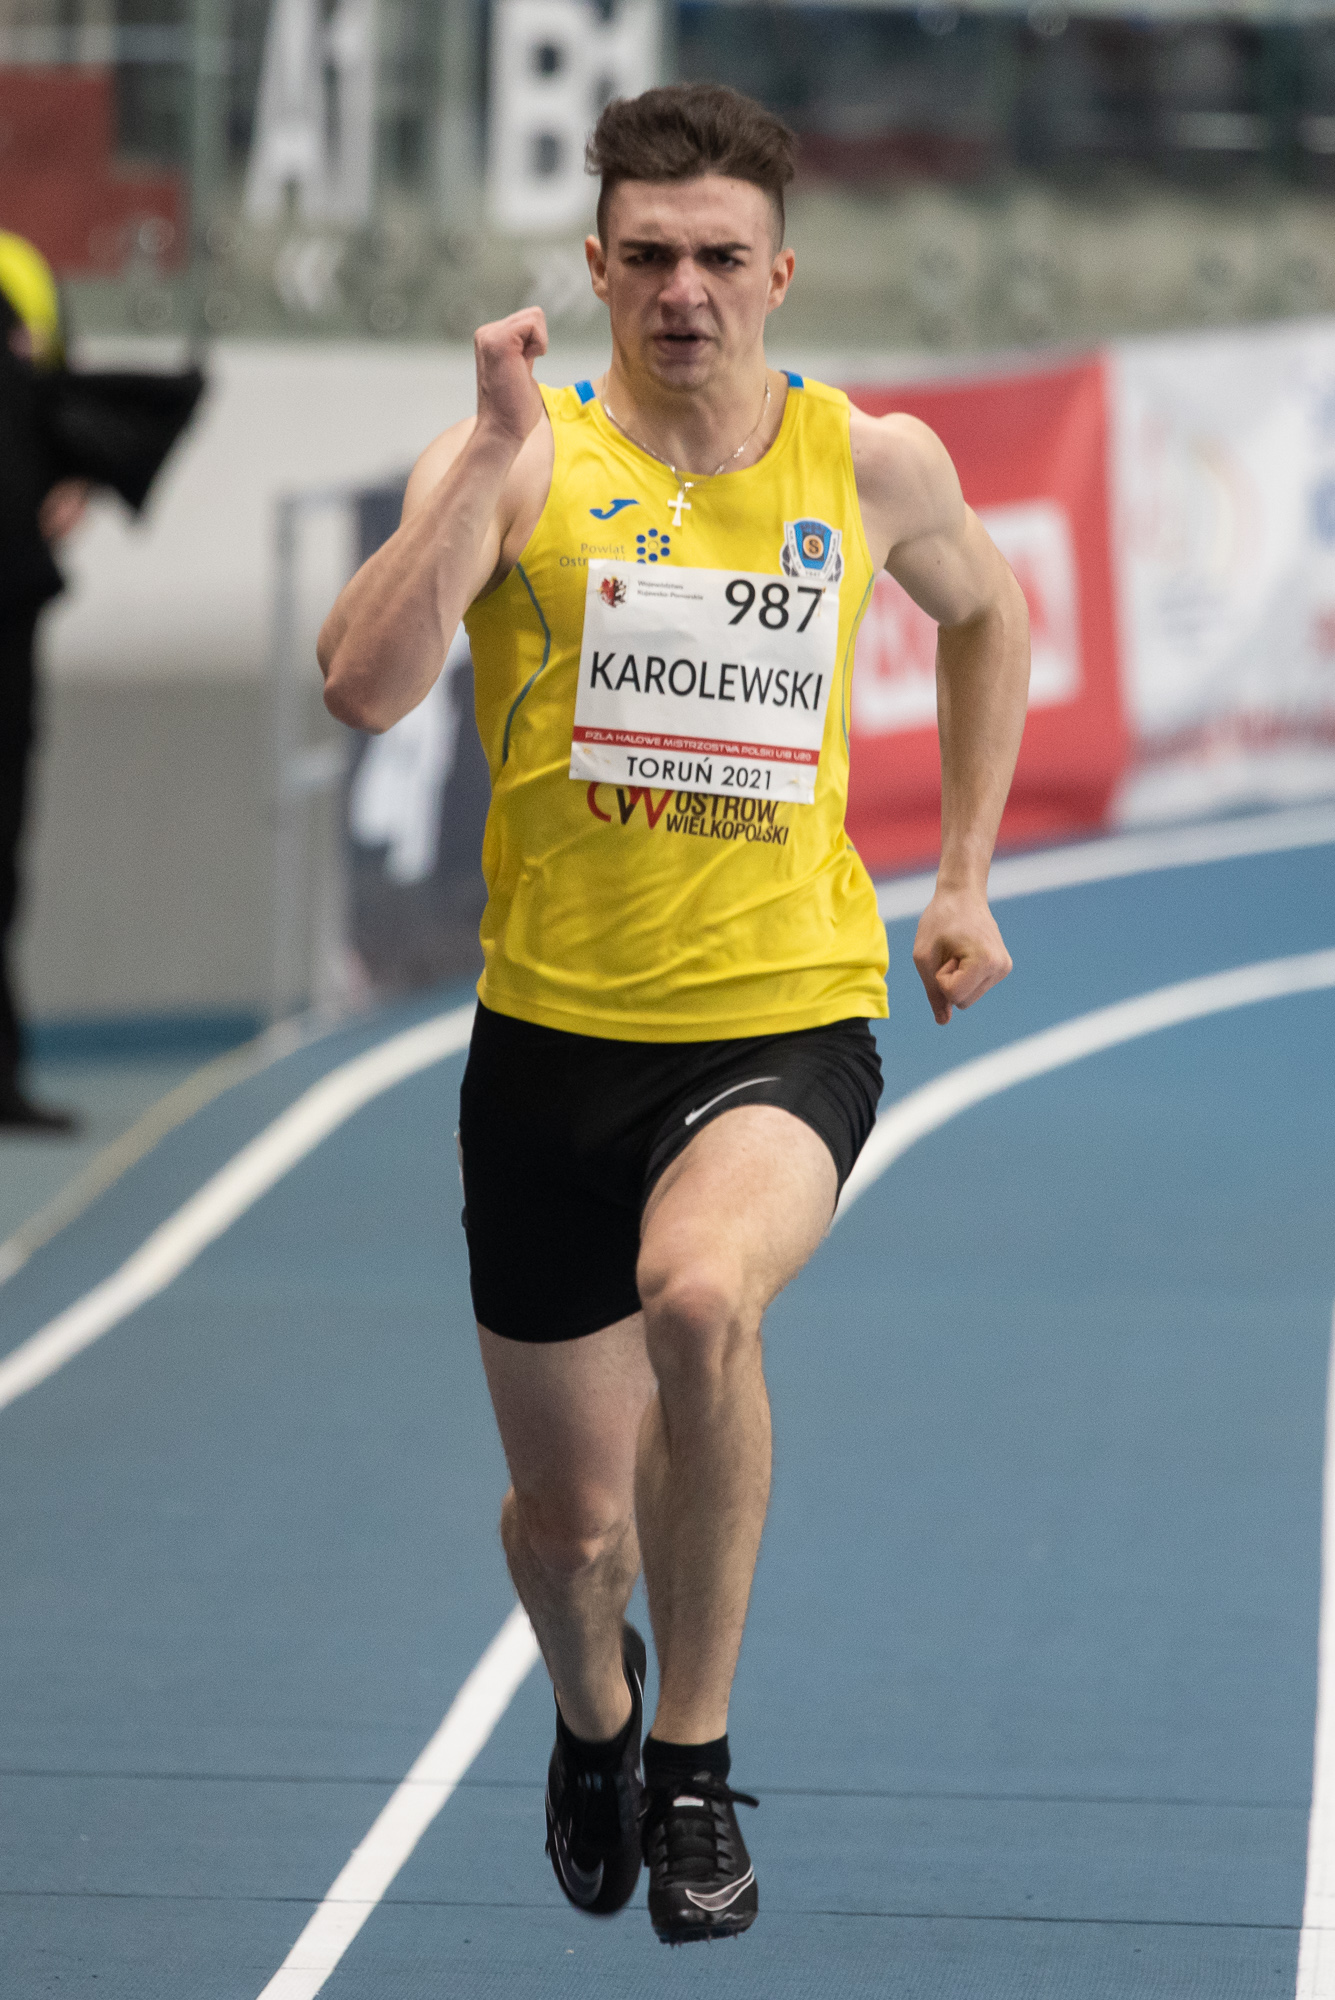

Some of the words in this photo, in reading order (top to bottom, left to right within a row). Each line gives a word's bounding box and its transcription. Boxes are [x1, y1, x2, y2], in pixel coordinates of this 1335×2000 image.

[580, 543, 625, 555] Powiat
[725, 579, 823, 633] 987
[590, 651, 823, 711] KAROLEWSKI
[585, 731, 613, 741] PZLA
[616, 735, 661, 747] HALOWE
[664, 739, 739, 754] MISTRZOSTWA
[742, 746, 775, 758] POLSKI
[627, 756, 713, 784] TORUŃ
[721, 766, 772, 790] 2021
[666, 813, 789, 846] WIELKOPOLSKI
